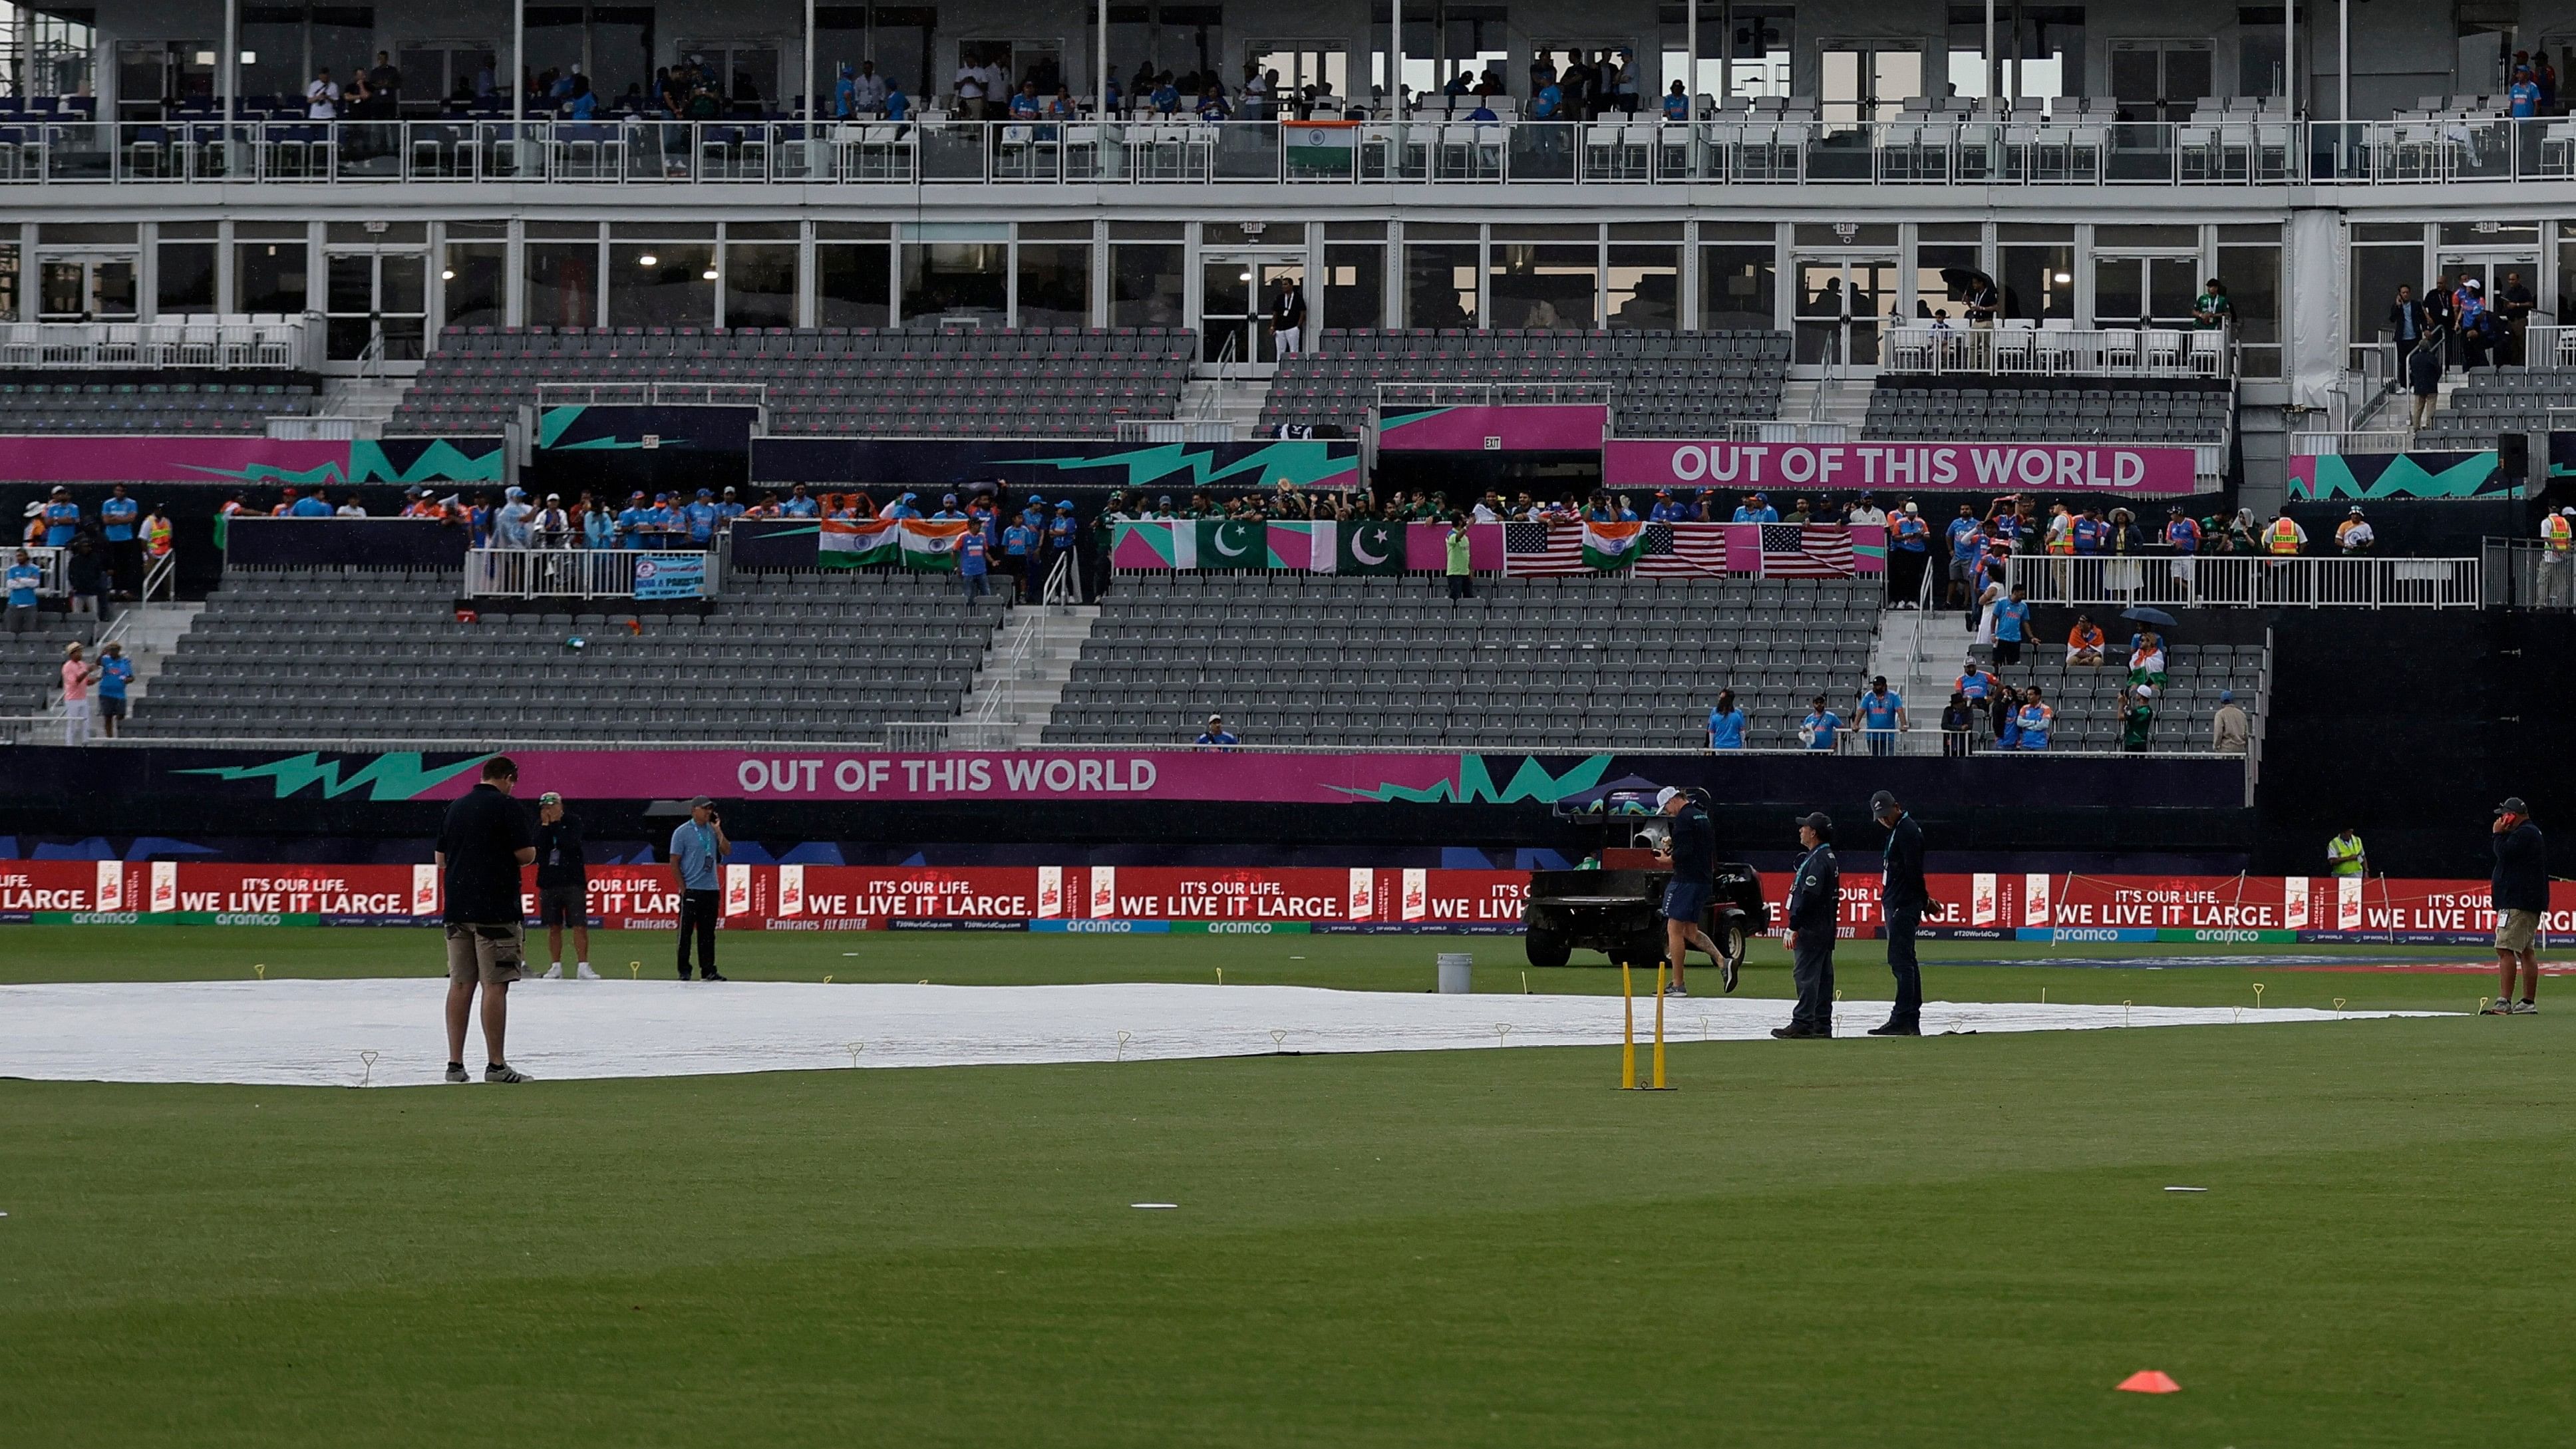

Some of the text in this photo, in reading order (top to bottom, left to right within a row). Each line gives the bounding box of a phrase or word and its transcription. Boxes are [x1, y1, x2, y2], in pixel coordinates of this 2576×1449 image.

[643, 436, 658, 446] EXIT
[1486, 438, 1500, 448] EXIT
[1672, 445, 2145, 486] OUT OF THIS WORLD
[738, 758, 1156, 792] OUT OF THIS WORLD
[242, 878, 349, 892] IT'S OUR LIFE.
[587, 879, 661, 892] OUR LIFE.
[869, 880, 973, 895] IT'S OUR LIFE.
[1180, 882, 1285, 895] IT'S OUR LIFE.
[1492, 884, 1519, 897] IT'S
[3, 889, 92, 910] LARGE.
[1838, 887, 1868, 901] OUR
[2116, 890, 2219, 904] IT'S OUR LIFE.
[2428, 893, 2493, 907] IT'S OUR
[181, 891, 408, 914] WE LIVE IT LARGE.
[603, 893, 626, 913] IT
[808, 895, 847, 915] WE
[856, 895, 907, 915] LIVE
[915, 895, 938, 915] IT
[947, 895, 1032, 916] LARGE.
[1120, 896, 1343, 917] WE LIVE IT LARGE.
[1432, 898, 1470, 918] WE
[71, 911, 138, 924] aramco
[1850, 903, 1873, 921] IT
[2056, 904, 2094, 923] WE
[2102, 904, 2152, 924] LIVE
[2162, 905, 2184, 925] IT
[2192, 905, 2279, 926] LARGE.
[2368, 907, 2406, 927] WE
[2415, 909, 2466, 929] LIVE
[2475, 910, 2496, 929] IT
[215, 913, 281, 926] aramco
[624, 917, 678, 929] Emirates
[766, 918, 868, 930] Emirates FLY BETTER
[1066, 920, 1132, 933] aramco
[1208, 922, 1272, 934] aramco
[1954, 930, 2000, 939] #T20WorldCup
[2055, 929, 2118, 941] aramco
[2195, 929, 2259, 941] aramco
